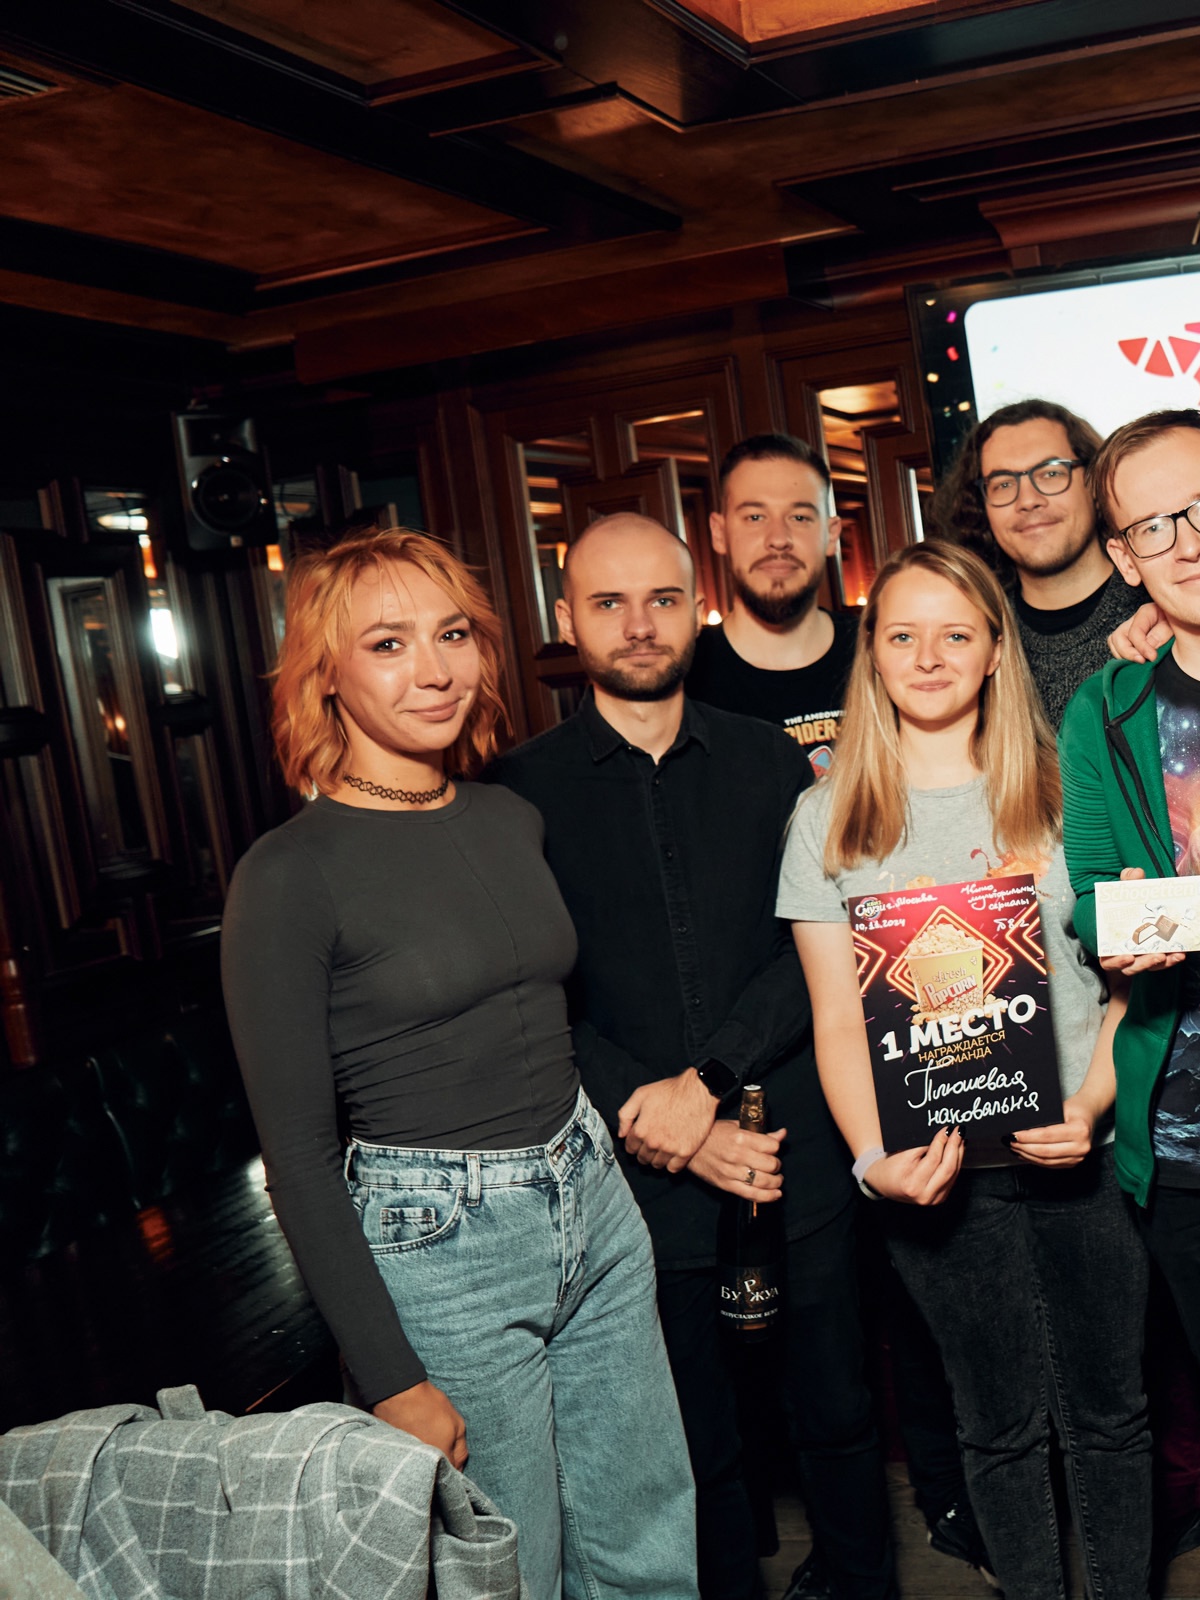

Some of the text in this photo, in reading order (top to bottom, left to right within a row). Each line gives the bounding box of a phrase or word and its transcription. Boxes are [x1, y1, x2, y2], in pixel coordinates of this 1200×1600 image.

[784, 715, 803, 726] THE
[988, 898, 1029, 911] сериалы
[1100, 881, 1194, 902] Schogetten
[922, 975, 977, 1010] POPCORN
[881, 994, 1037, 1061] 1 МЕСТО
[918, 1030, 1006, 1063] НАГРАЖДАЕТСЯ
[935, 1046, 993, 1068] КОМАНДА
[904, 1055, 1028, 1109] Плюшевая
[927, 1092, 1040, 1127] наковальня
